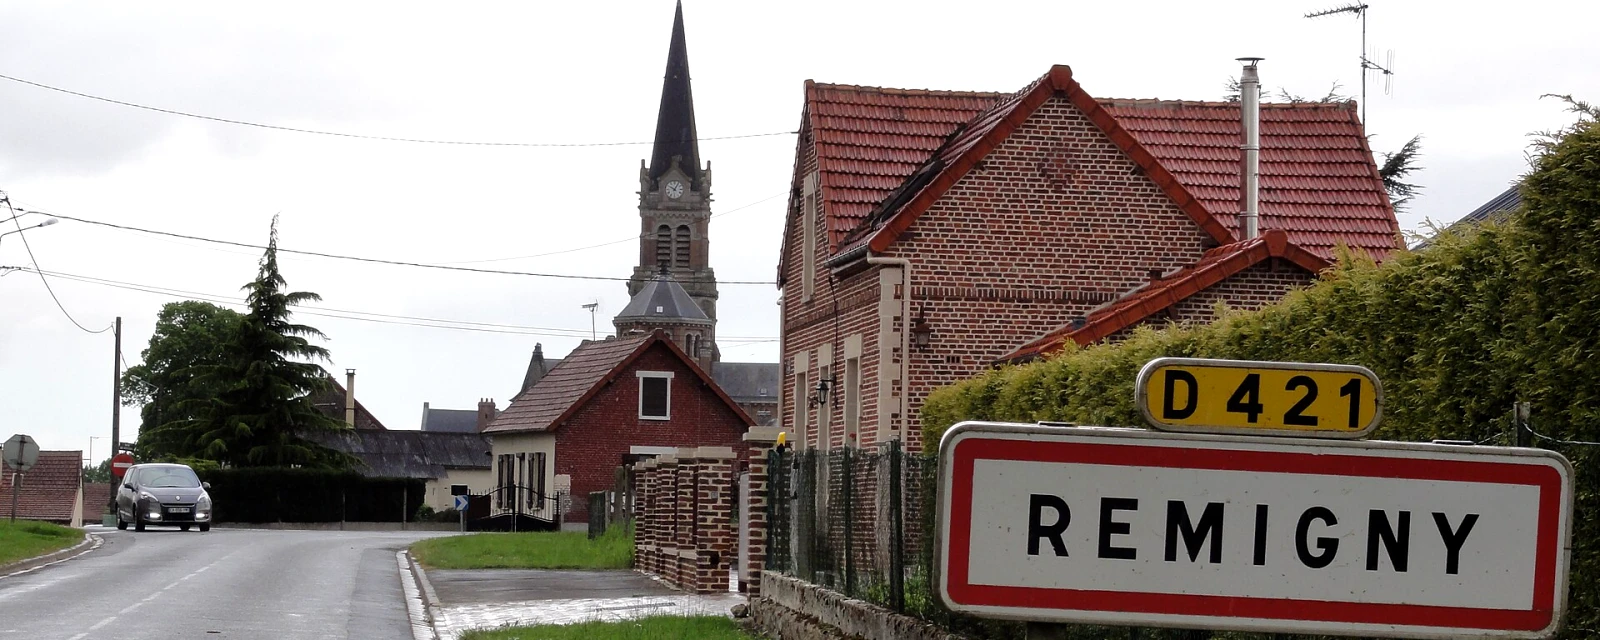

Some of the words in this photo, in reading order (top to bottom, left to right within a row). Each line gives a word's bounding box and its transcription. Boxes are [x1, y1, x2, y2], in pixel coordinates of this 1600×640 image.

[1163, 369, 1199, 421] D
[1226, 373, 1362, 429] 421
[1027, 493, 1480, 575] REMIGNY
